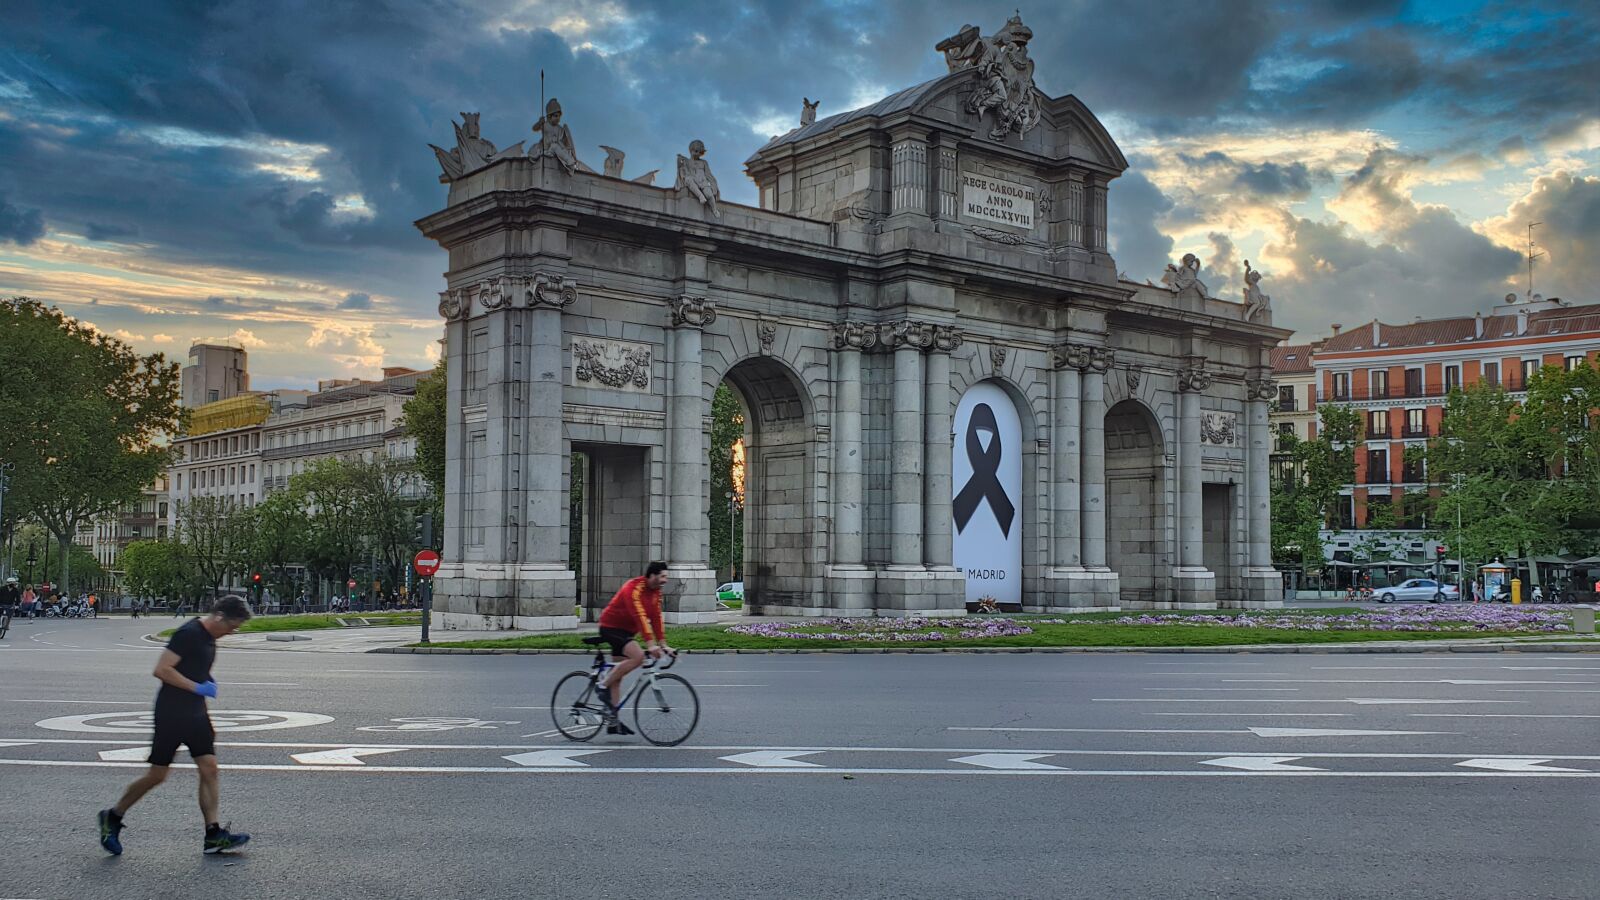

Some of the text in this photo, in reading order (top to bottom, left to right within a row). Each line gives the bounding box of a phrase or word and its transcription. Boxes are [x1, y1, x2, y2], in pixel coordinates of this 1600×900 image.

[963, 176, 1035, 201] REGE CAROLO III
[987, 194, 1013, 209] ANNO
[968, 203, 1030, 225] MDCCLXXVIII
[968, 569, 1006, 580] MADRID
